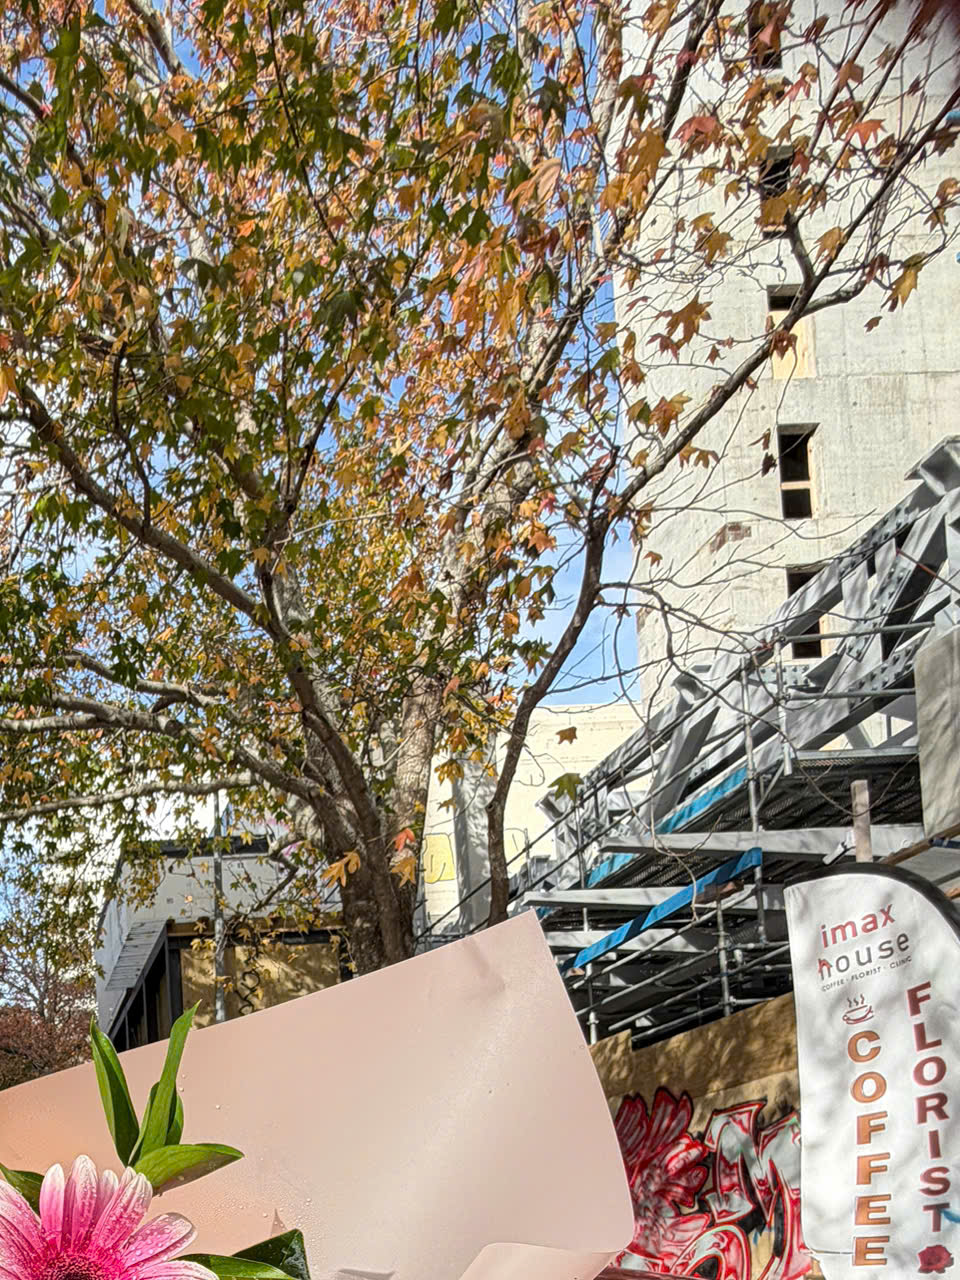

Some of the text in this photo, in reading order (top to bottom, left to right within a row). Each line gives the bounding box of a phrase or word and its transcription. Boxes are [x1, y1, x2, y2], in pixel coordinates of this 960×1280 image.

[820, 903, 896, 949] imax
[817, 932, 910, 981] house
[822, 978, 845, 992] COFFEE
[851, 966, 881, 981] FLORIST
[906, 981, 951, 1234] FLORIST
[847, 1029, 891, 1267] COFFEE
